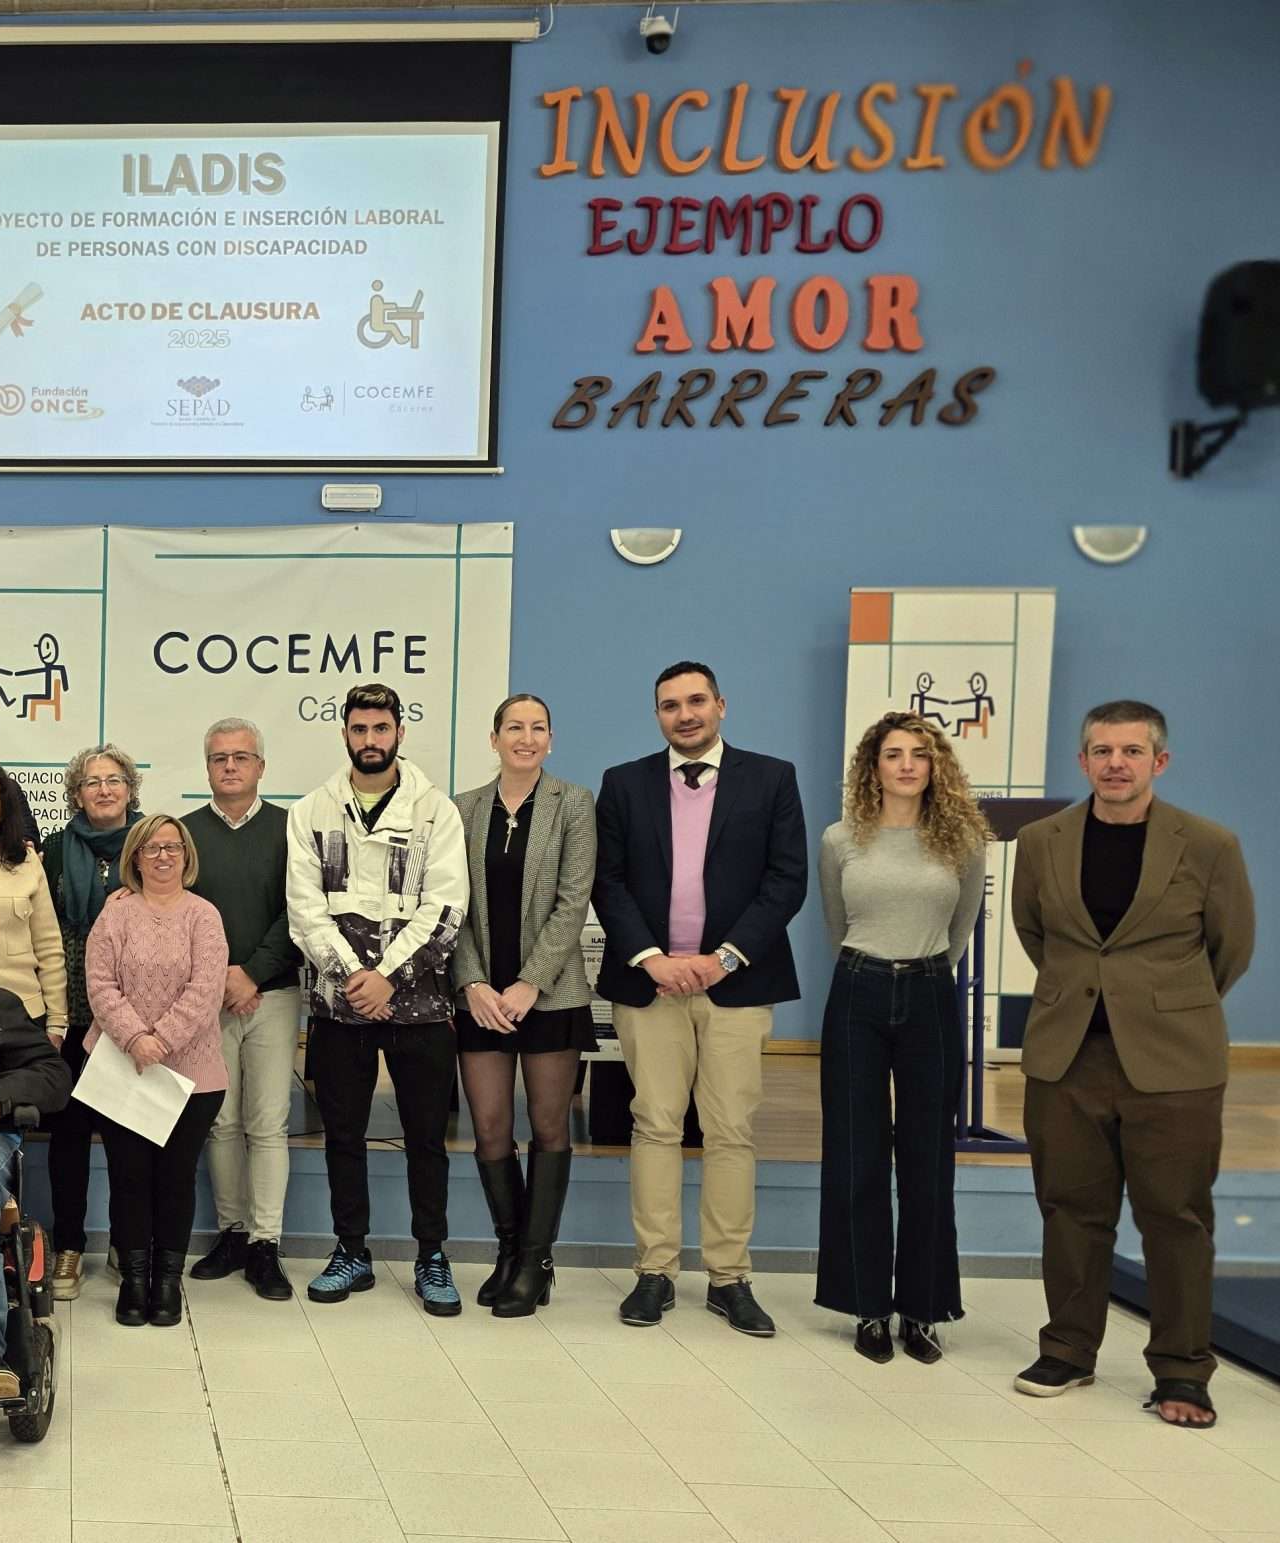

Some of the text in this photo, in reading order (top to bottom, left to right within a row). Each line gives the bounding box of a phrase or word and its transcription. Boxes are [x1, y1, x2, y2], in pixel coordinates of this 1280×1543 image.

[539, 59, 1114, 179] INCLUSIÓN
[123, 152, 286, 196] ILADIS
[70, 212, 96, 228] DE
[102, 207, 217, 228] FORMACIÓN
[224, 211, 235, 226] E
[242, 206, 347, 226] INSERCIÓN
[354, 209, 445, 225] LABORAL
[587, 192, 885, 256] EJEMPLO
[36, 239, 368, 257] DE PERSONAS CON DISCAPACIDAD
[80, 302, 321, 321] ACTO DE CLAUSURA
[635, 273, 924, 353] AMOR
[167, 328, 231, 349] 2025
[31, 386, 89, 397] Fundación
[353, 385, 434, 399] COCEMFE
[552, 366, 998, 430] BARRERAS
[30, 399, 89, 413] ONCE
[166, 399, 232, 417] SEPAD
[153, 630, 427, 674] COCEMFE
[8, 772, 64, 784] OCIACIO
